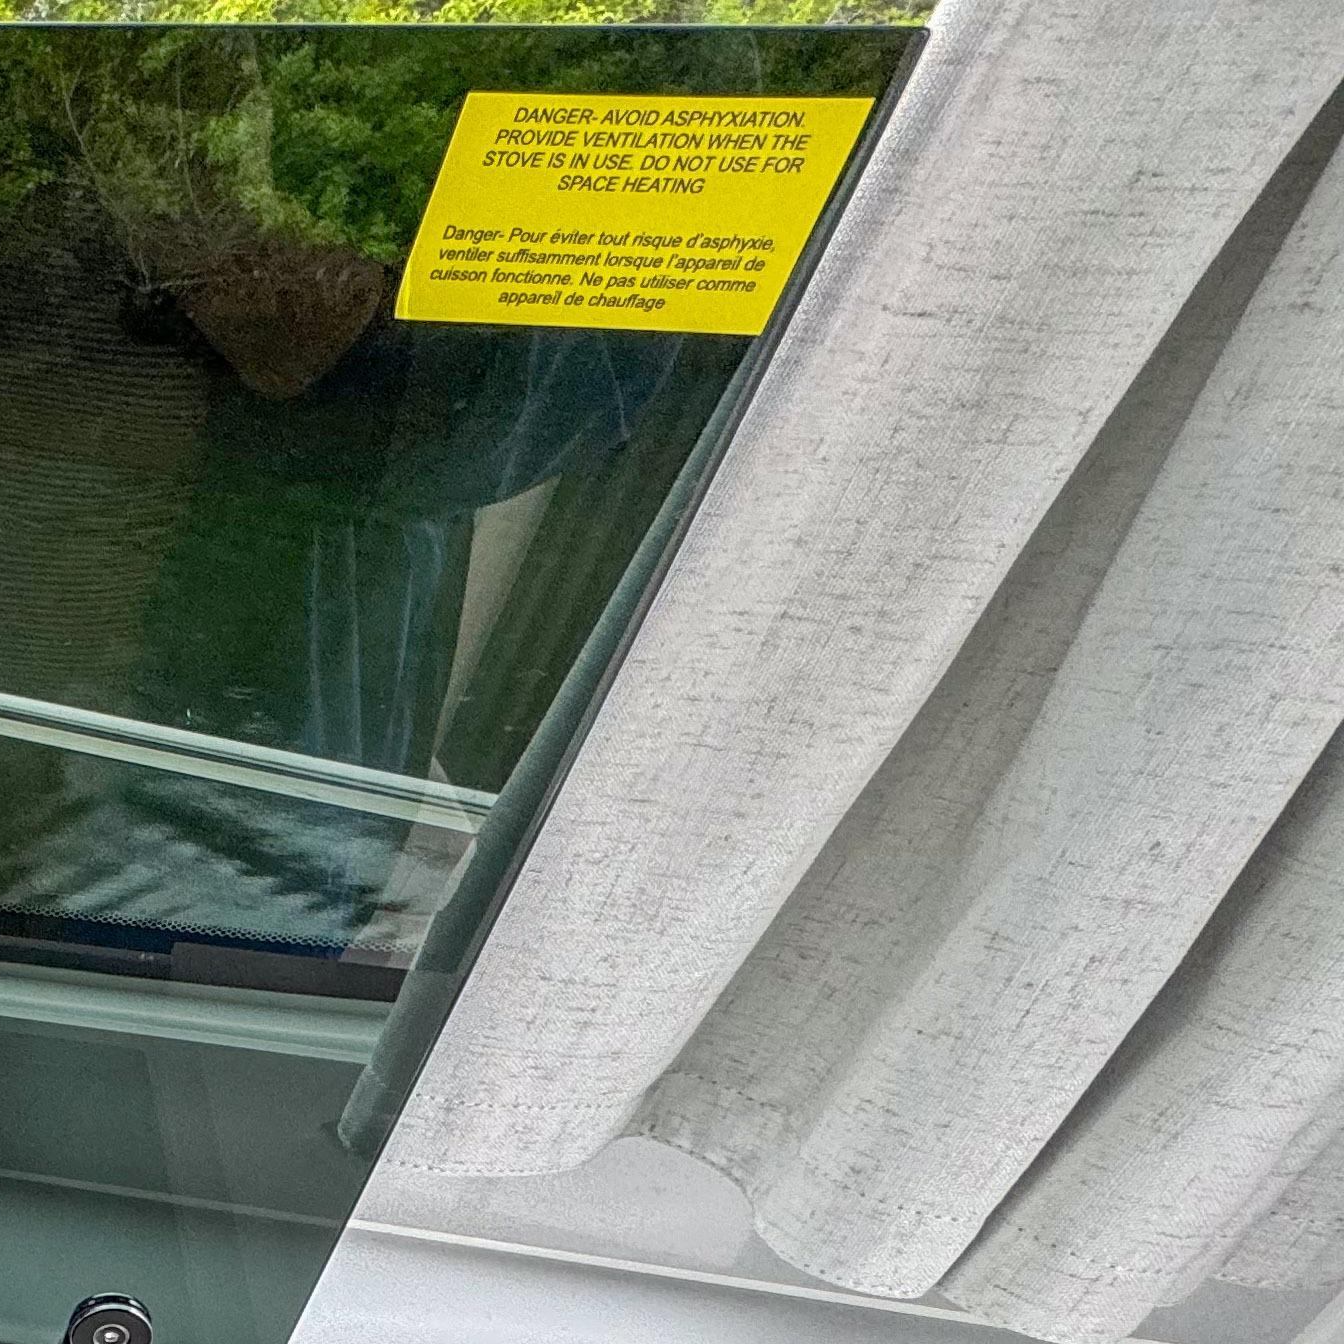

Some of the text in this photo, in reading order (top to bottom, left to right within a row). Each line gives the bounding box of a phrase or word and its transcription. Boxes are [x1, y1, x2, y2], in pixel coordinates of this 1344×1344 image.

[513, 107, 806, 128] DANGER- AVOID ASPHYXIATION.
[494, 129, 812, 151] PROVIDE VENTILATION WHEN THE
[482, 150, 546, 168] STOVE
[547, 152, 567, 169] IS
[569, 153, 591, 169] IN
[640, 155, 671, 171] DO
[672, 156, 717, 172] NOT
[718, 157, 761, 173] USE
[761, 157, 806, 174] FOR
[557, 174, 706, 194] SPACE HEATING
[442, 225, 505, 245] Danger-
[508, 227, 548, 244] Pour
[549, 229, 595, 246] éviter
[597, 231, 631, 247] tout
[631, 232, 683, 250] risque
[439, 248, 766, 273] ventiler suffisamment lorsque l'appareil de
[430, 267, 757, 293] cuisson fonctionne. Ne pas utiliser comme
[498, 291, 666, 312] appareil de chauffage
